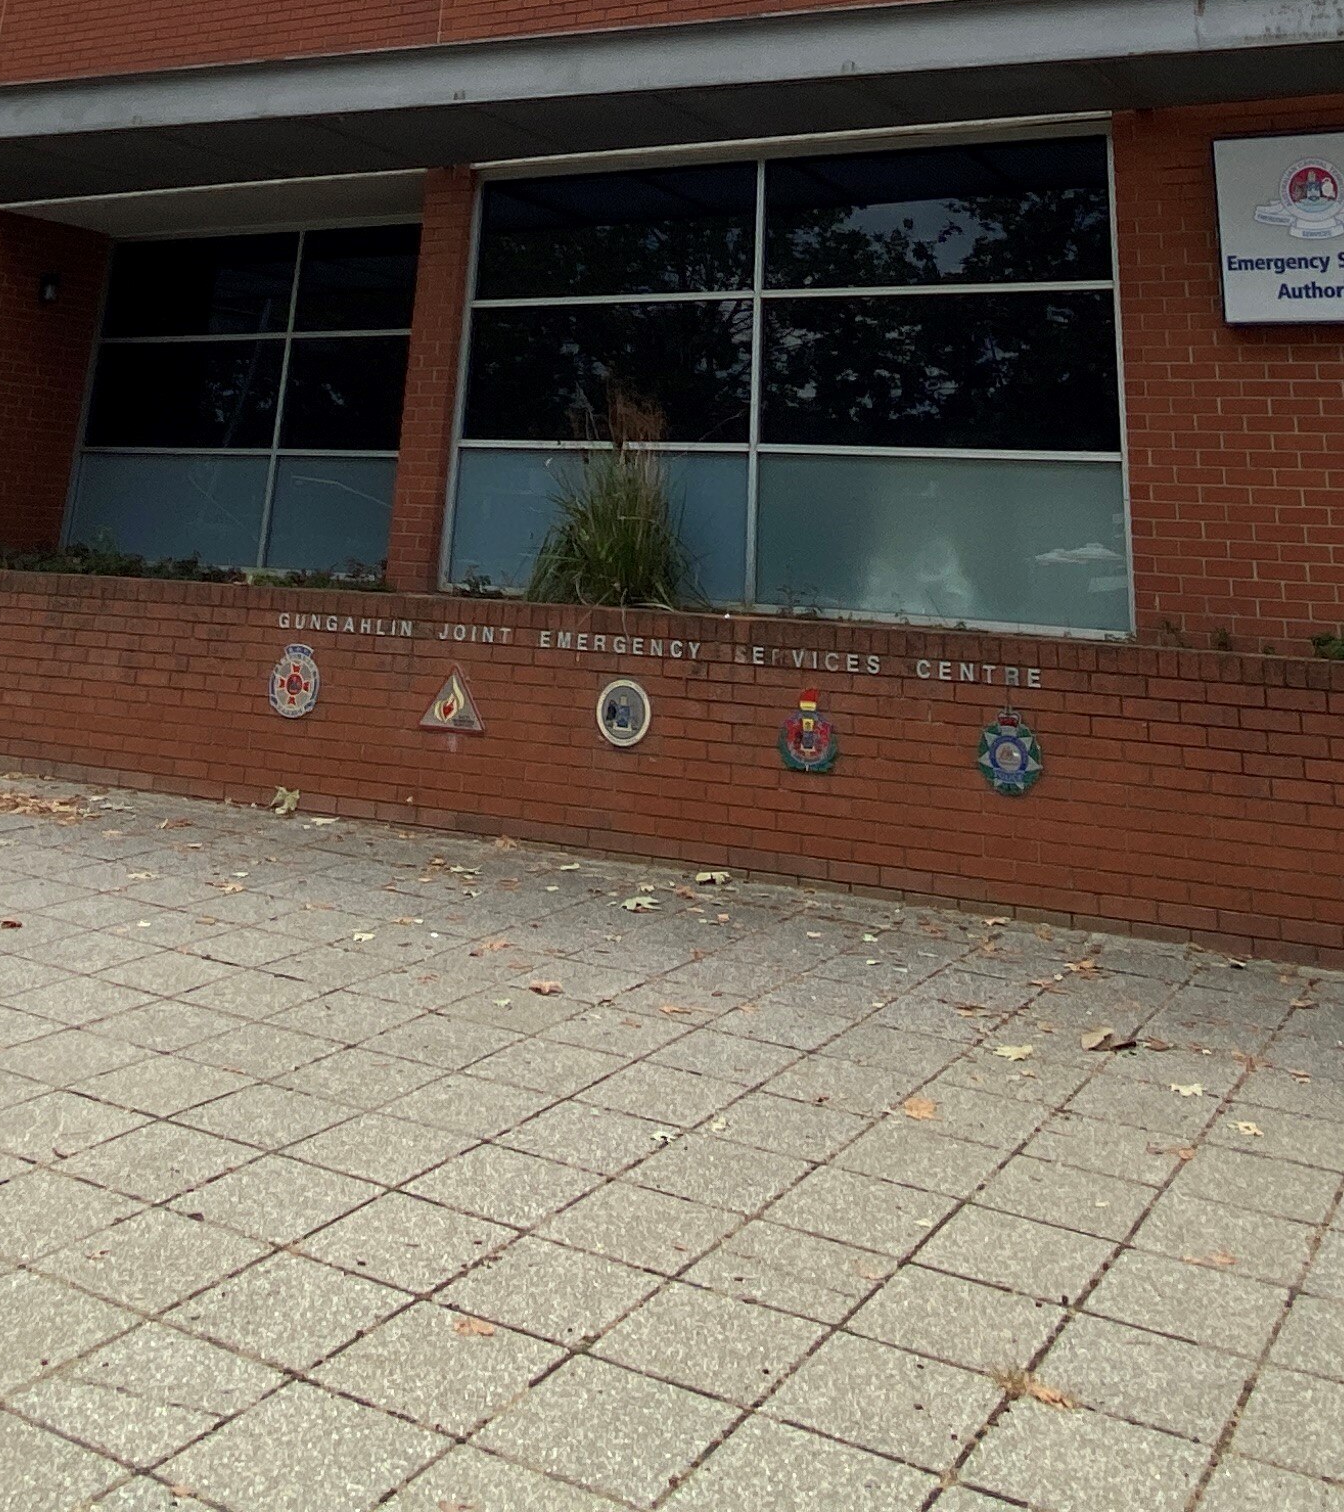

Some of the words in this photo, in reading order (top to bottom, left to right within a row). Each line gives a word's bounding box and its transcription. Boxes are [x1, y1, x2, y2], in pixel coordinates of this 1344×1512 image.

[1227, 252, 1330, 275] Emergency
[278, 613, 413, 637] GUNGAHLIN
[439, 624, 512, 645] JOINT
[540, 631, 701, 660] EMERGENCY
[916, 659, 1042, 689] CENTRE
